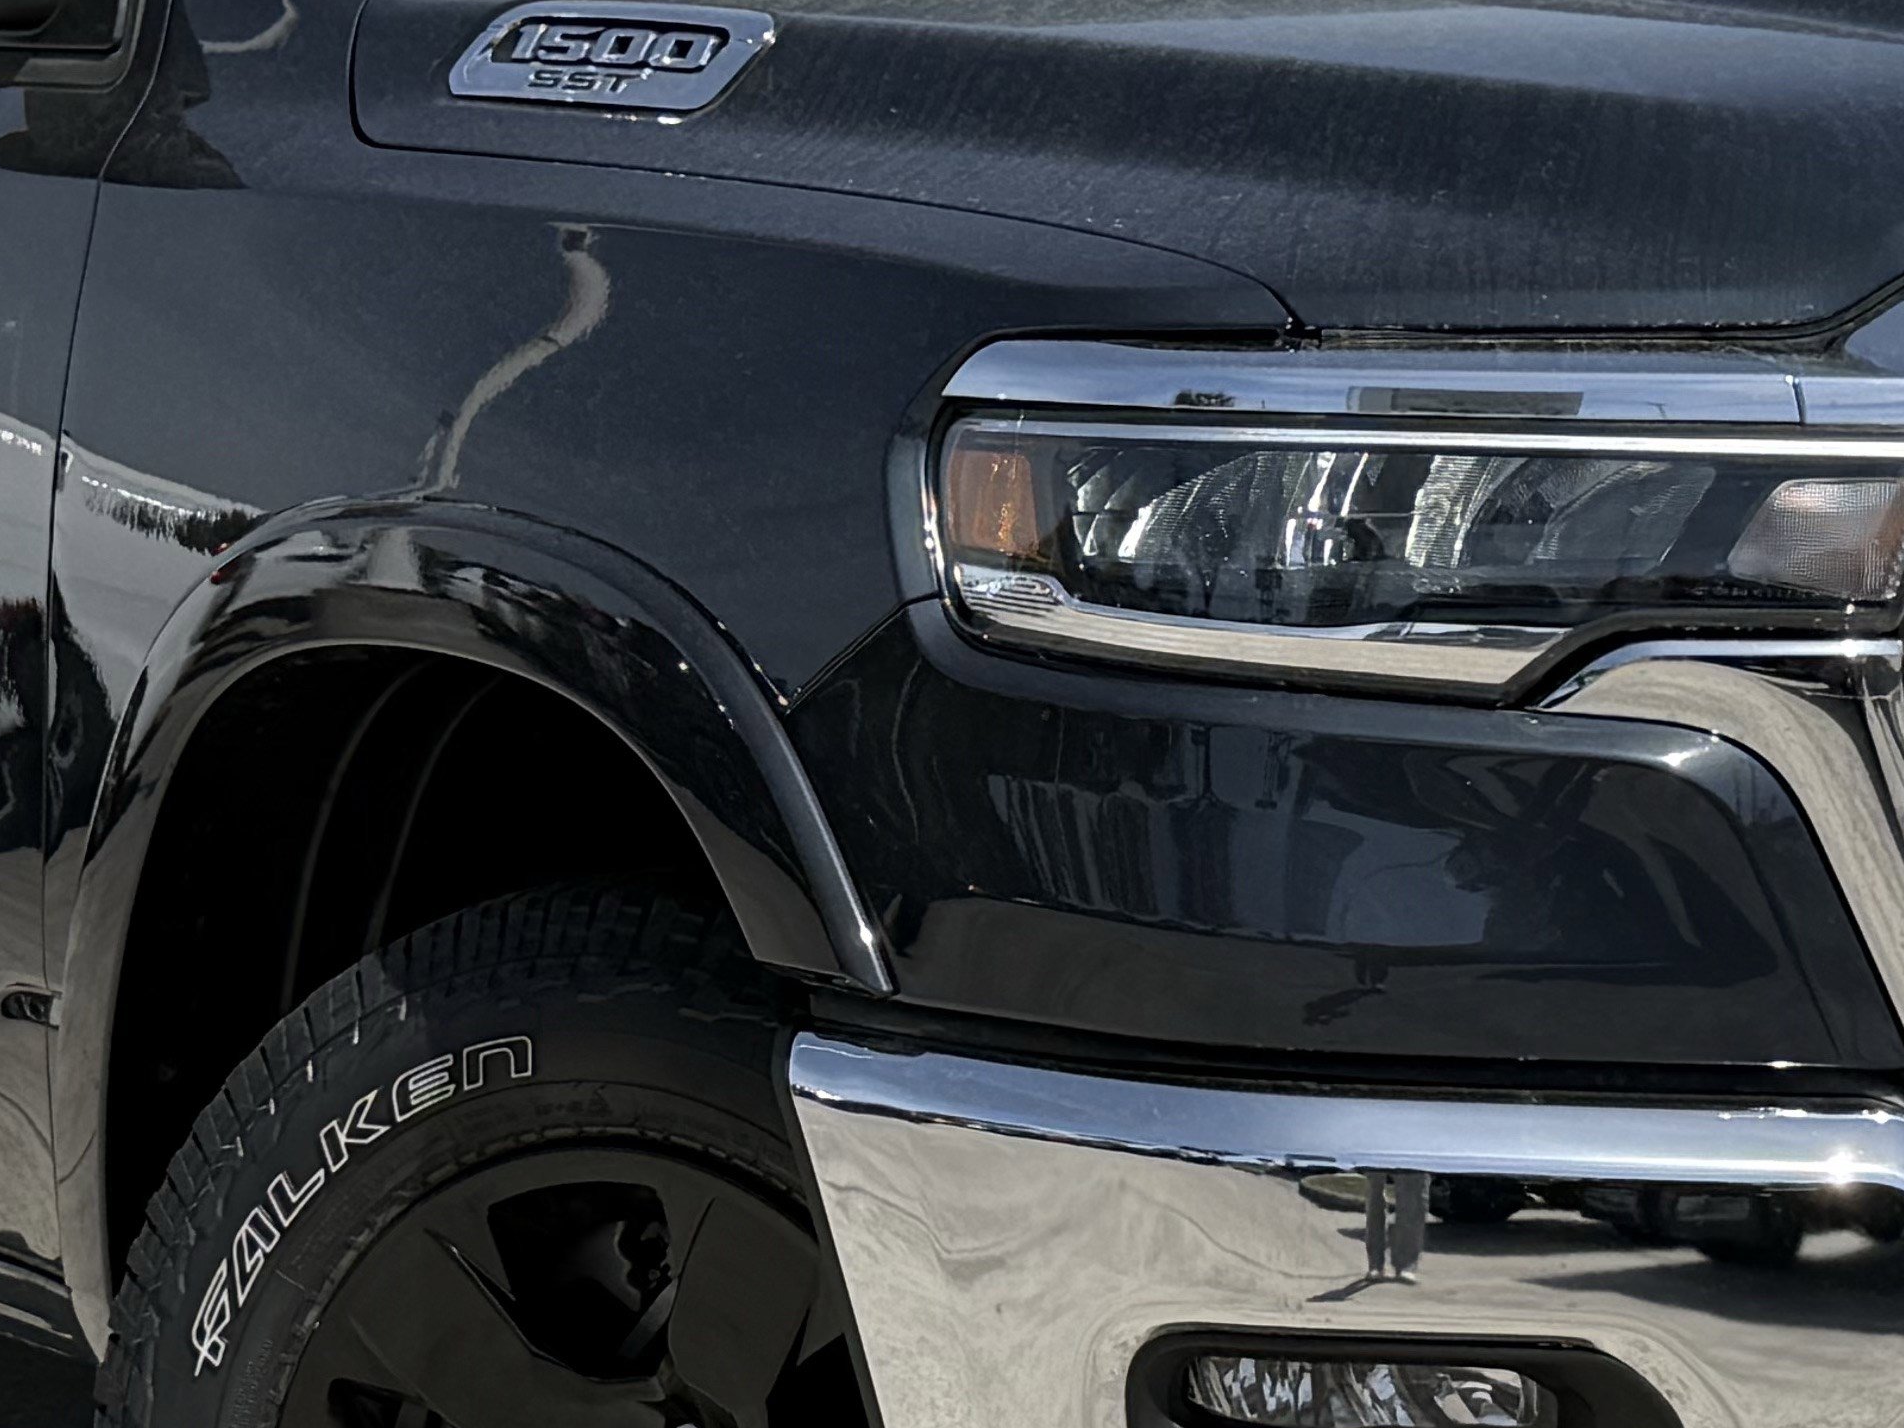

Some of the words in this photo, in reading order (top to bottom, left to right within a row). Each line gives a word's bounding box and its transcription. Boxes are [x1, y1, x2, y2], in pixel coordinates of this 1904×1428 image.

[511, 22, 721, 70] 1500
[527, 69, 640, 94] SST
[192, 1034, 533, 1377] FALKEN
